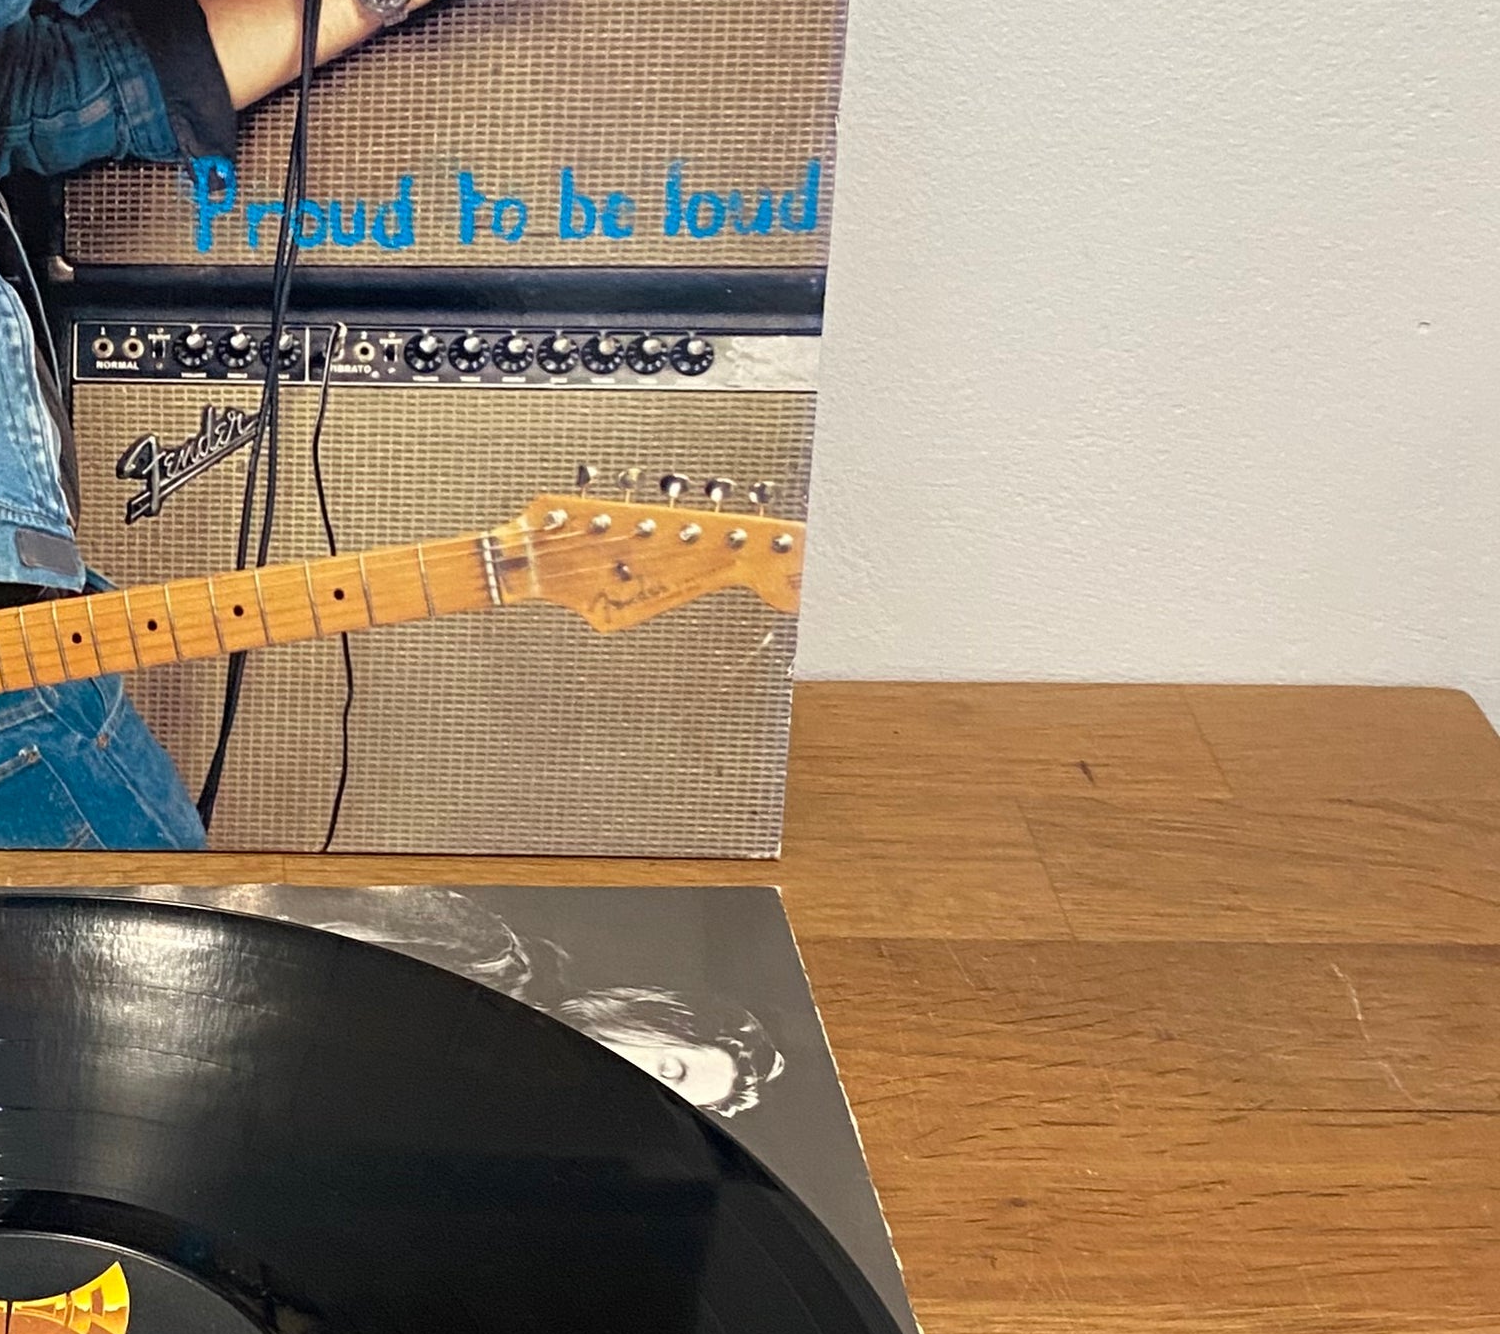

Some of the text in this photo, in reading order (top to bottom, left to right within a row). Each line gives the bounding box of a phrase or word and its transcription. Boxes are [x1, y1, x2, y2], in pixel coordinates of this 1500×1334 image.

[192, 155, 821, 253] Proud to be loud
[96, 360, 139, 370] NORMAL
[117, 404, 260, 519] Fender
